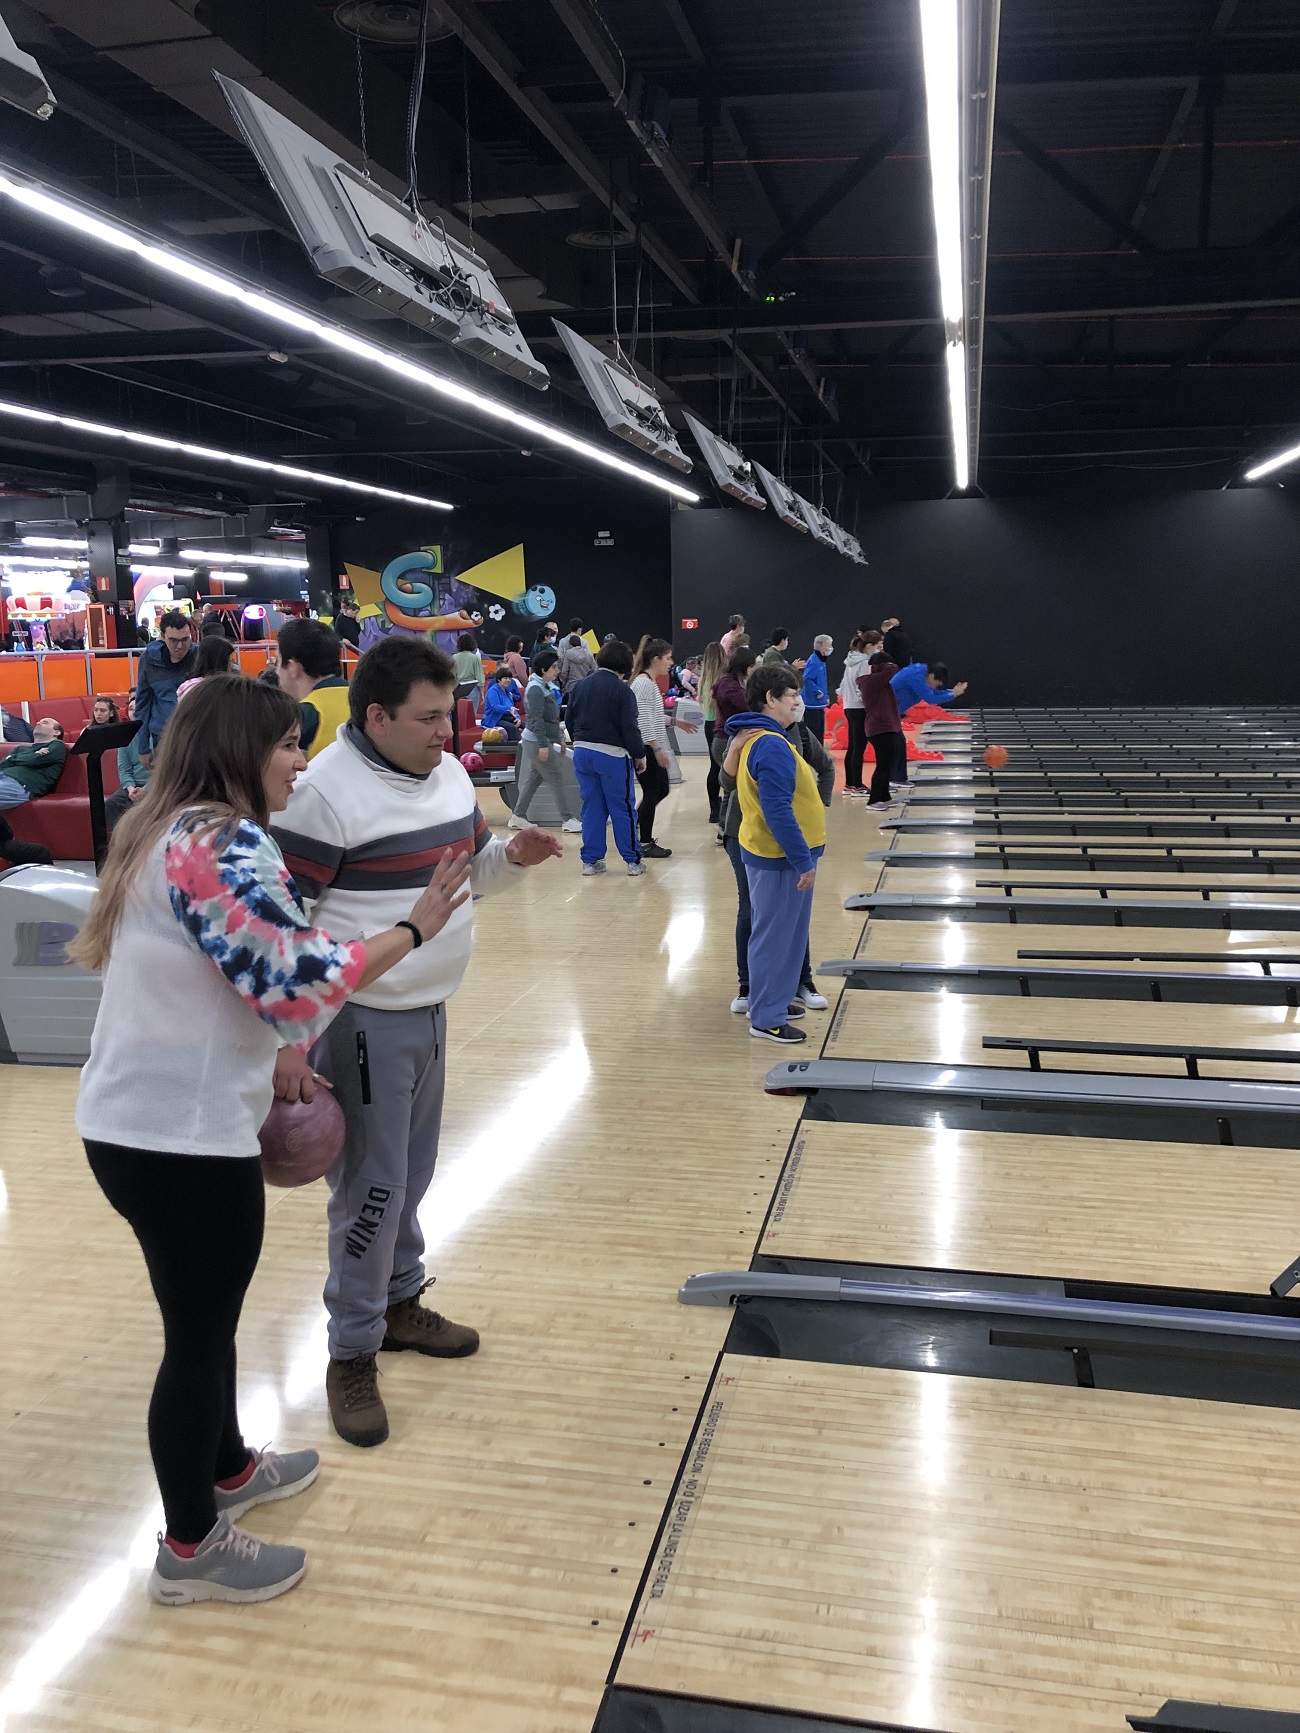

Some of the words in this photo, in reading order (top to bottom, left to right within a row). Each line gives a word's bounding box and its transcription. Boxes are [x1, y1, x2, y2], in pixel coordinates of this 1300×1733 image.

[345, 1186, 391, 1259] DENIM
[706, 1401, 724, 1427] PELIGRO
[702, 1428, 715, 1438] DE
[691, 1438, 712, 1473] RESBALON
[686, 1479, 699, 1490] NO
[671, 1522, 684, 1533] LA
[663, 1534, 681, 1558] LINEA
[658, 1559, 673, 1572] DE
[649, 1573, 669, 1598] FALTA
